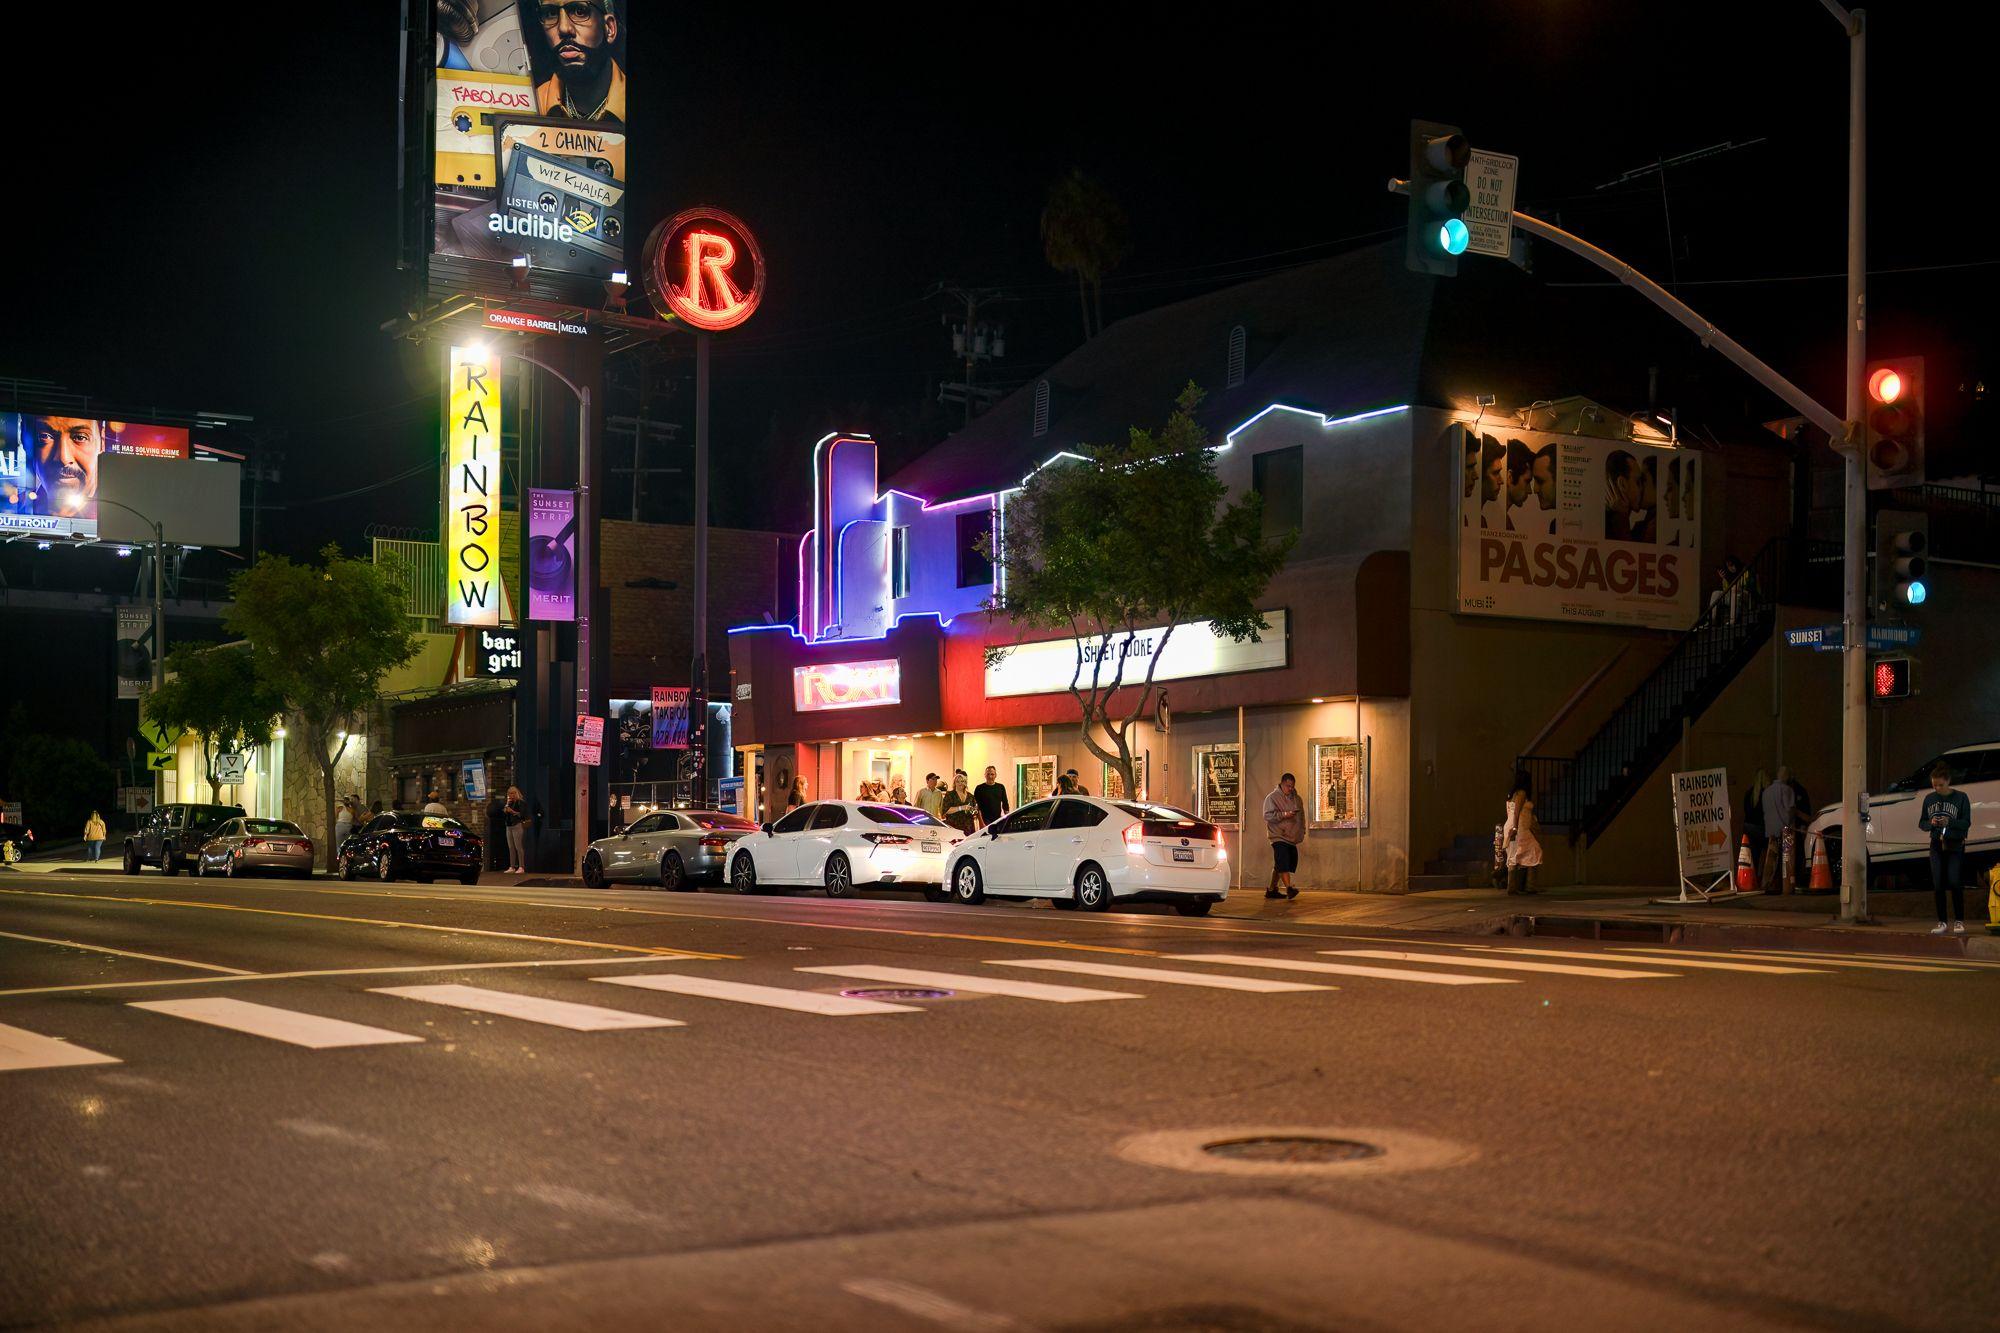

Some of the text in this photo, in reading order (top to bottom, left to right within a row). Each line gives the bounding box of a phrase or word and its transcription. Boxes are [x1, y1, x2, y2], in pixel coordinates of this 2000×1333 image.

[452, 86, 530, 108] FABOLOUS
[539, 131, 605, 153] 2 CHAINZ
[1484, 166, 1499, 176] ZONE
[539, 164, 611, 203] WIZ KHALIFA
[1477, 176, 1503, 192] DO NOT
[506, 197, 556, 213] LISTEN ON
[1478, 192, 1499, 206] BLOCK
[1467, 206, 1509, 223] NTERSECTION
[488, 212, 573, 243] audible
[677, 232, 748, 318] R
[489, 313, 588, 335] ORANGE BARREL MEDIA
[135, 446, 160, 455] SOLVING
[161, 448, 180, 457] CRIME
[459, 361, 490, 608] RAINBOW
[533, 499, 570, 509] SUNSET
[533, 512, 570, 521] STRIP
[1480, 538, 1679, 598] PASSAGES
[533, 594, 571, 603] MERIT
[1561, 607, 1605, 617] THIS AUGUST
[482, 630, 516, 651] bar
[1790, 630, 1822, 644] SUNSET
[1871, 627, 1908, 642] HAMMOND
[654, 690, 692, 702] RAINBOW
[654, 706, 674, 720] TAKE
[1680, 773, 1722, 792] RAINBOW
[1690, 792, 1714, 807] ROXY
[1684, 807, 1725, 826] PARKING
